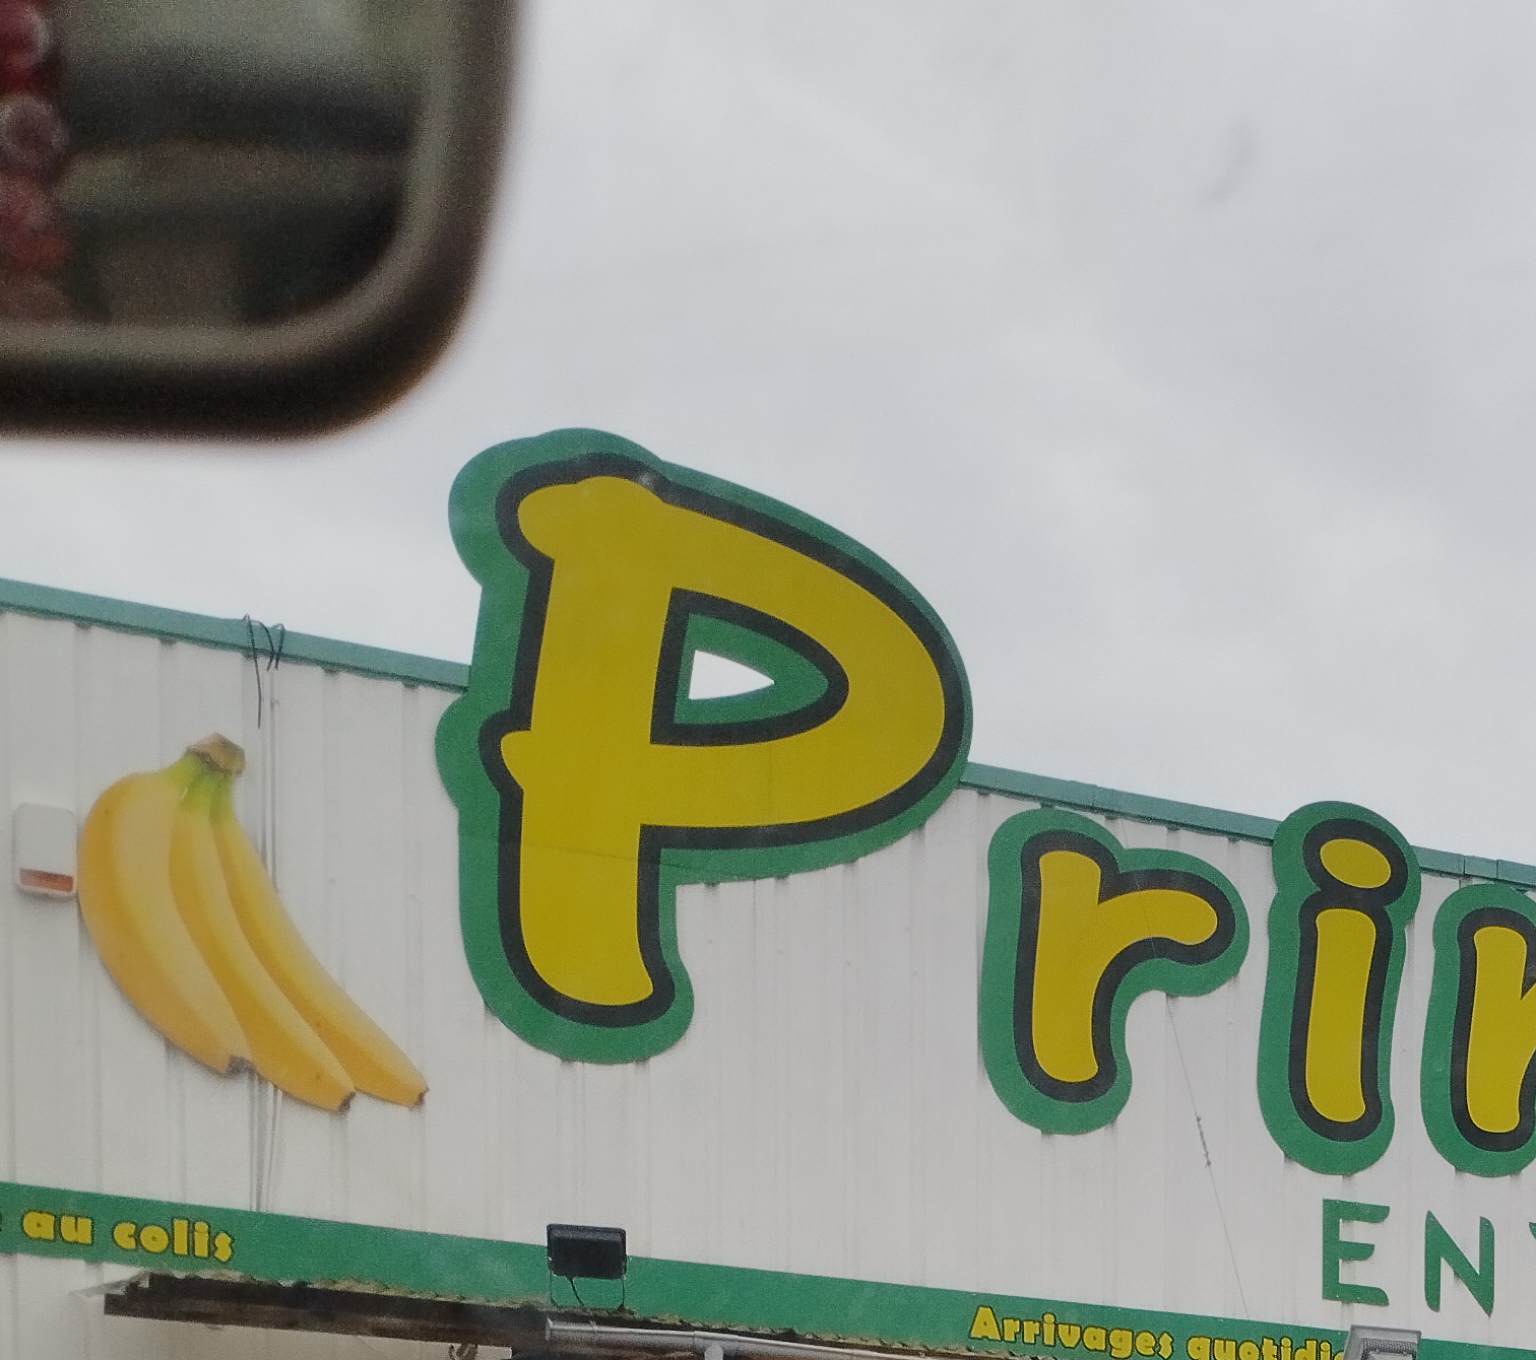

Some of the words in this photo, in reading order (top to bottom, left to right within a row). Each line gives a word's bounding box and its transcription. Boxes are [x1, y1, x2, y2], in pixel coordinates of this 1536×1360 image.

[22, 1209, 93, 1246] au
[112, 1217, 234, 1263] colis
[969, 1305, 1174, 1360] Arrivages
